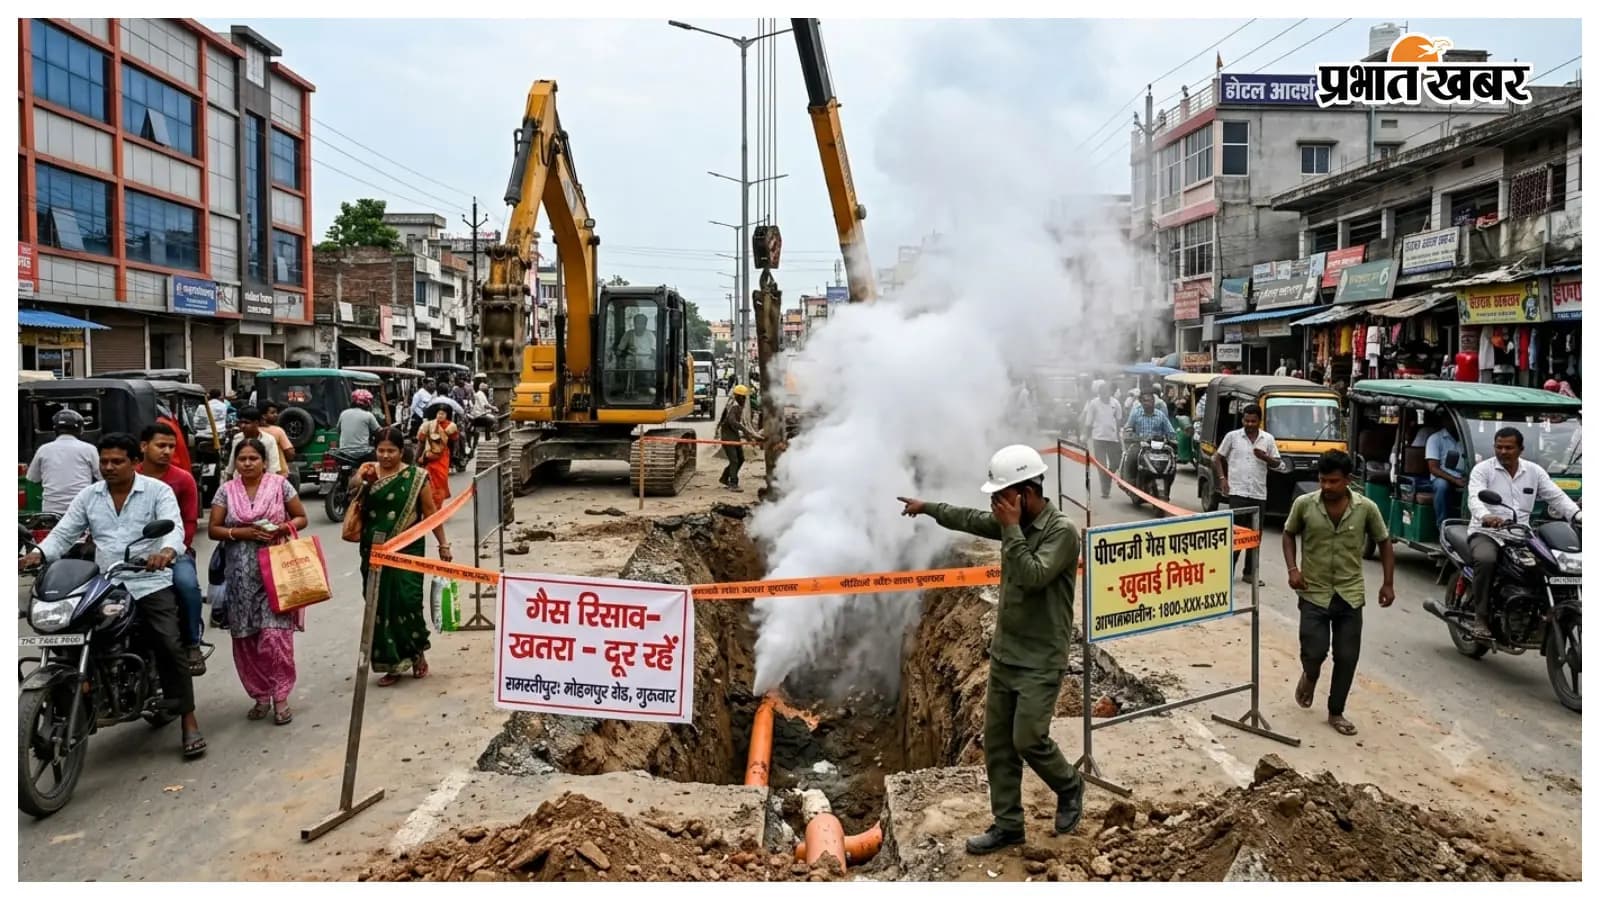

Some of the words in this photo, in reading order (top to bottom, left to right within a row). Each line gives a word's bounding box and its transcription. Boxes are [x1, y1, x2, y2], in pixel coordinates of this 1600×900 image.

[1269, 77, 1316, 100] आदर्श
[1094, 533, 1142, 565] पीएनजी
[1146, 531, 1165, 557] गैस
[1169, 527, 1228, 555] पाइपलाइन
[1119, 562, 1163, 605] खुदाई
[1166, 558, 1205, 590] निषेध
[526, 587, 570, 625] गैस
[508, 632, 576, 661] खतरा
[605, 640, 638, 677] दूर
[642, 634, 679, 671] रहें
